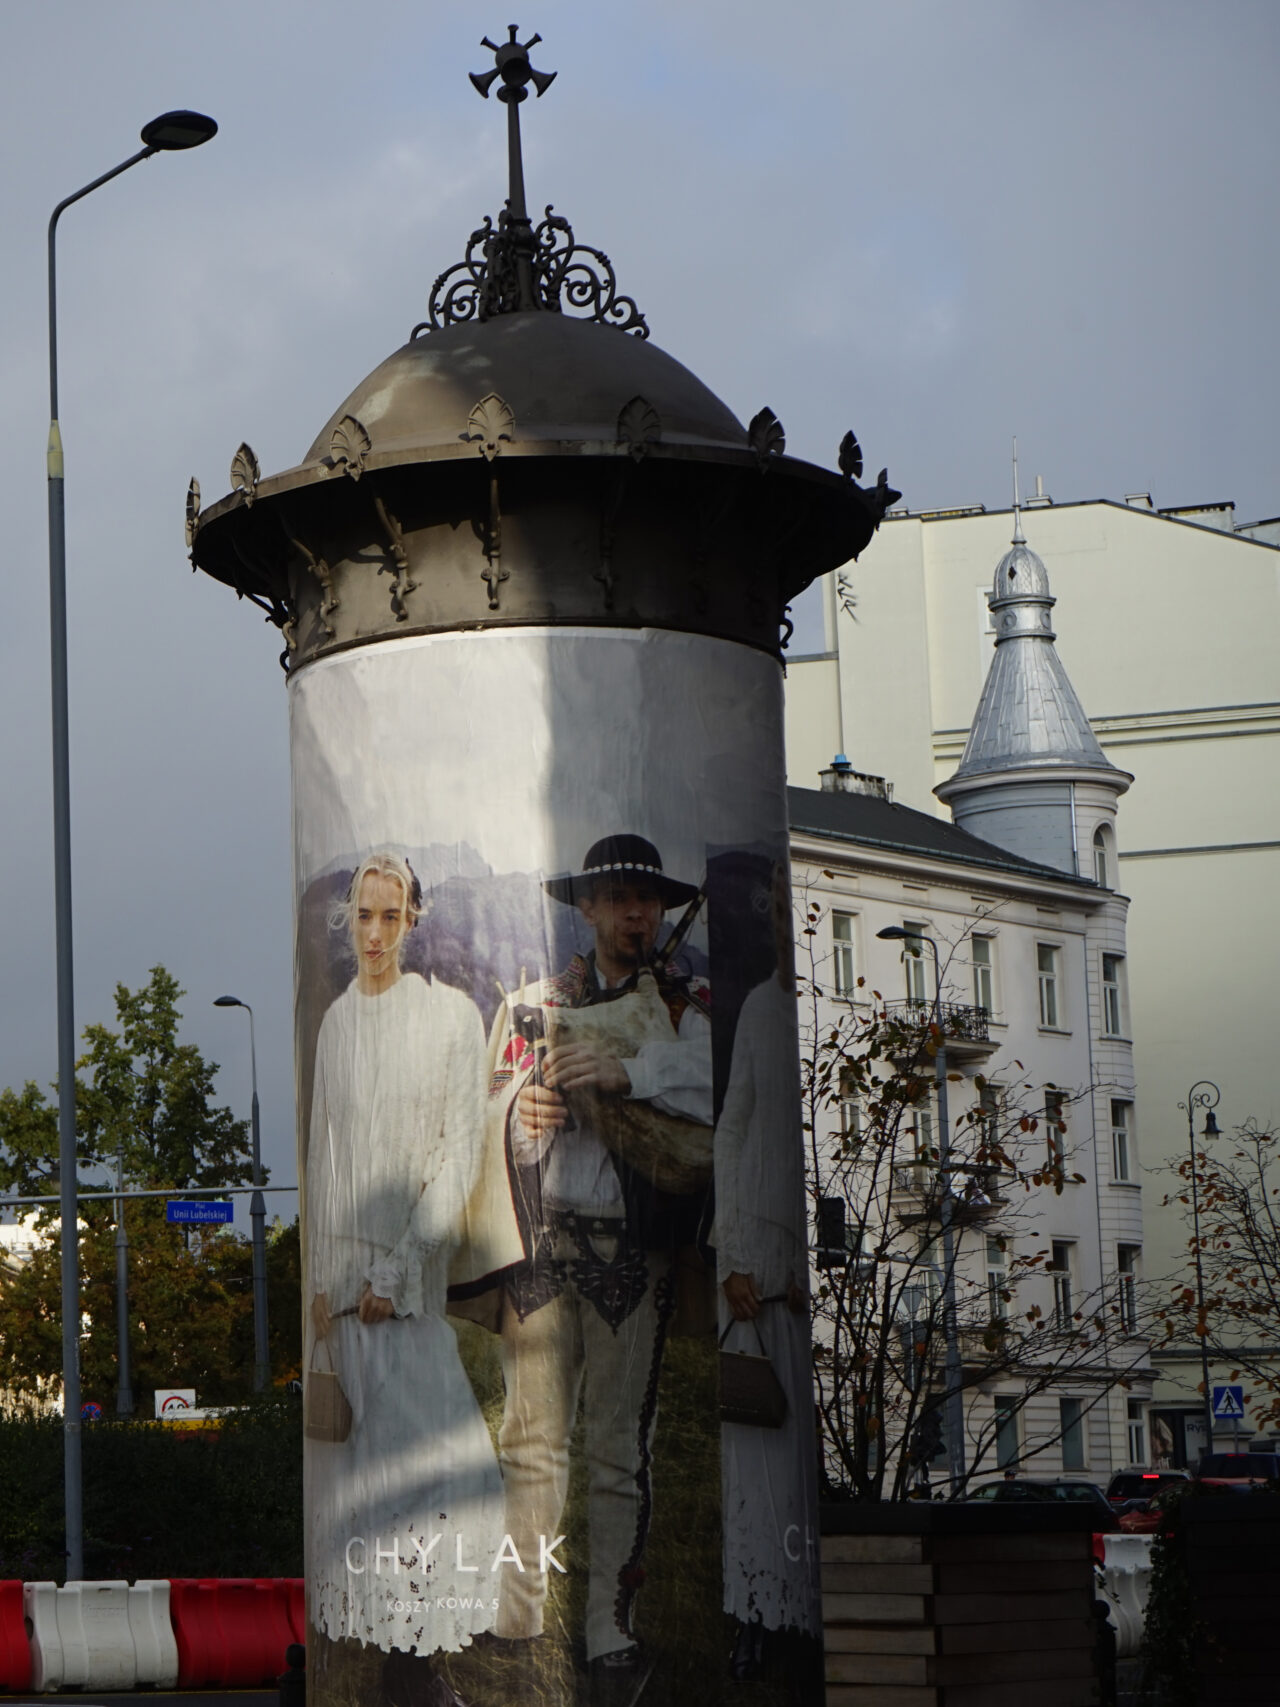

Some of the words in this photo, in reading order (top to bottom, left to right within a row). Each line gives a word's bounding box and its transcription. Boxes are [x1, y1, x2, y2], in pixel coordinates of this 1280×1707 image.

[190, 1210, 227, 1220] Lubelskiej
[346, 1533, 568, 1576] CHYLAK
[492, 1598, 500, 1610] 5
